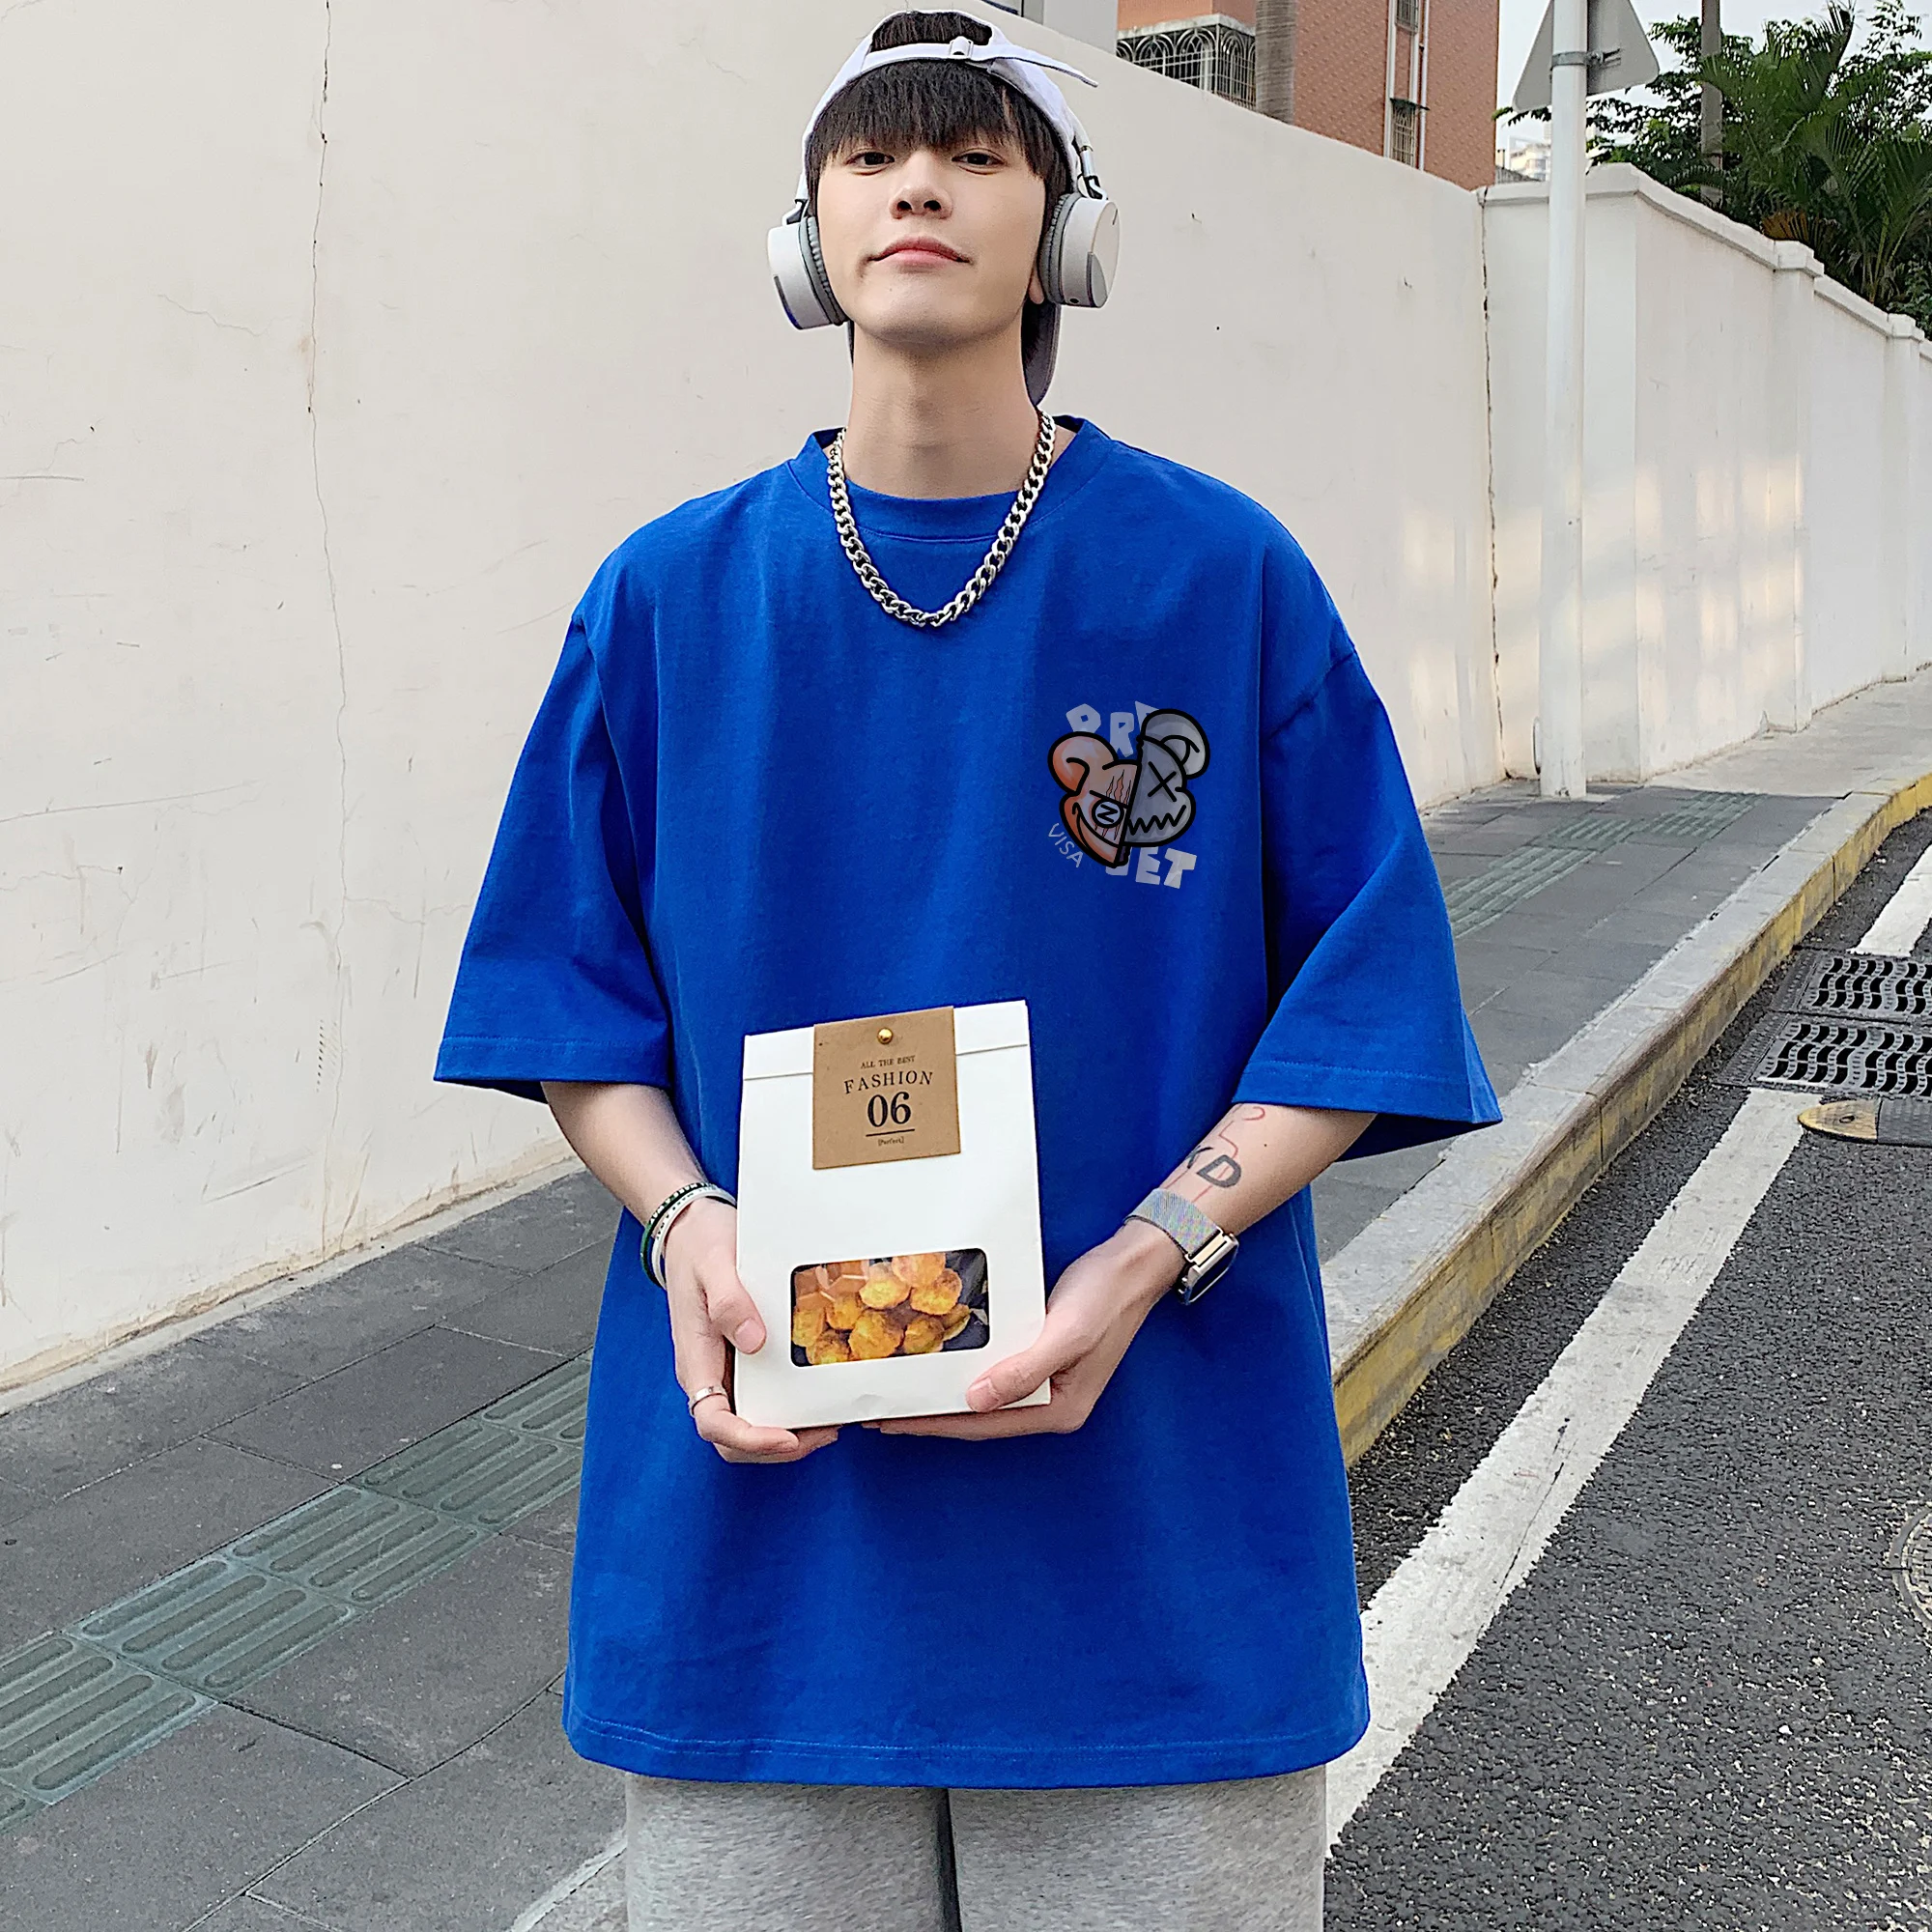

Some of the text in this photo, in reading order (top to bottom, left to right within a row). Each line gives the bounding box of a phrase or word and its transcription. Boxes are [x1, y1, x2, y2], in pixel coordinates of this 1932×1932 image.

[1048, 822, 1084, 868] VISA
[861, 1055, 916, 1069] ALL THE BEST
[843, 1069, 933, 1094] FASHION
[867, 1091, 912, 1128] 06
